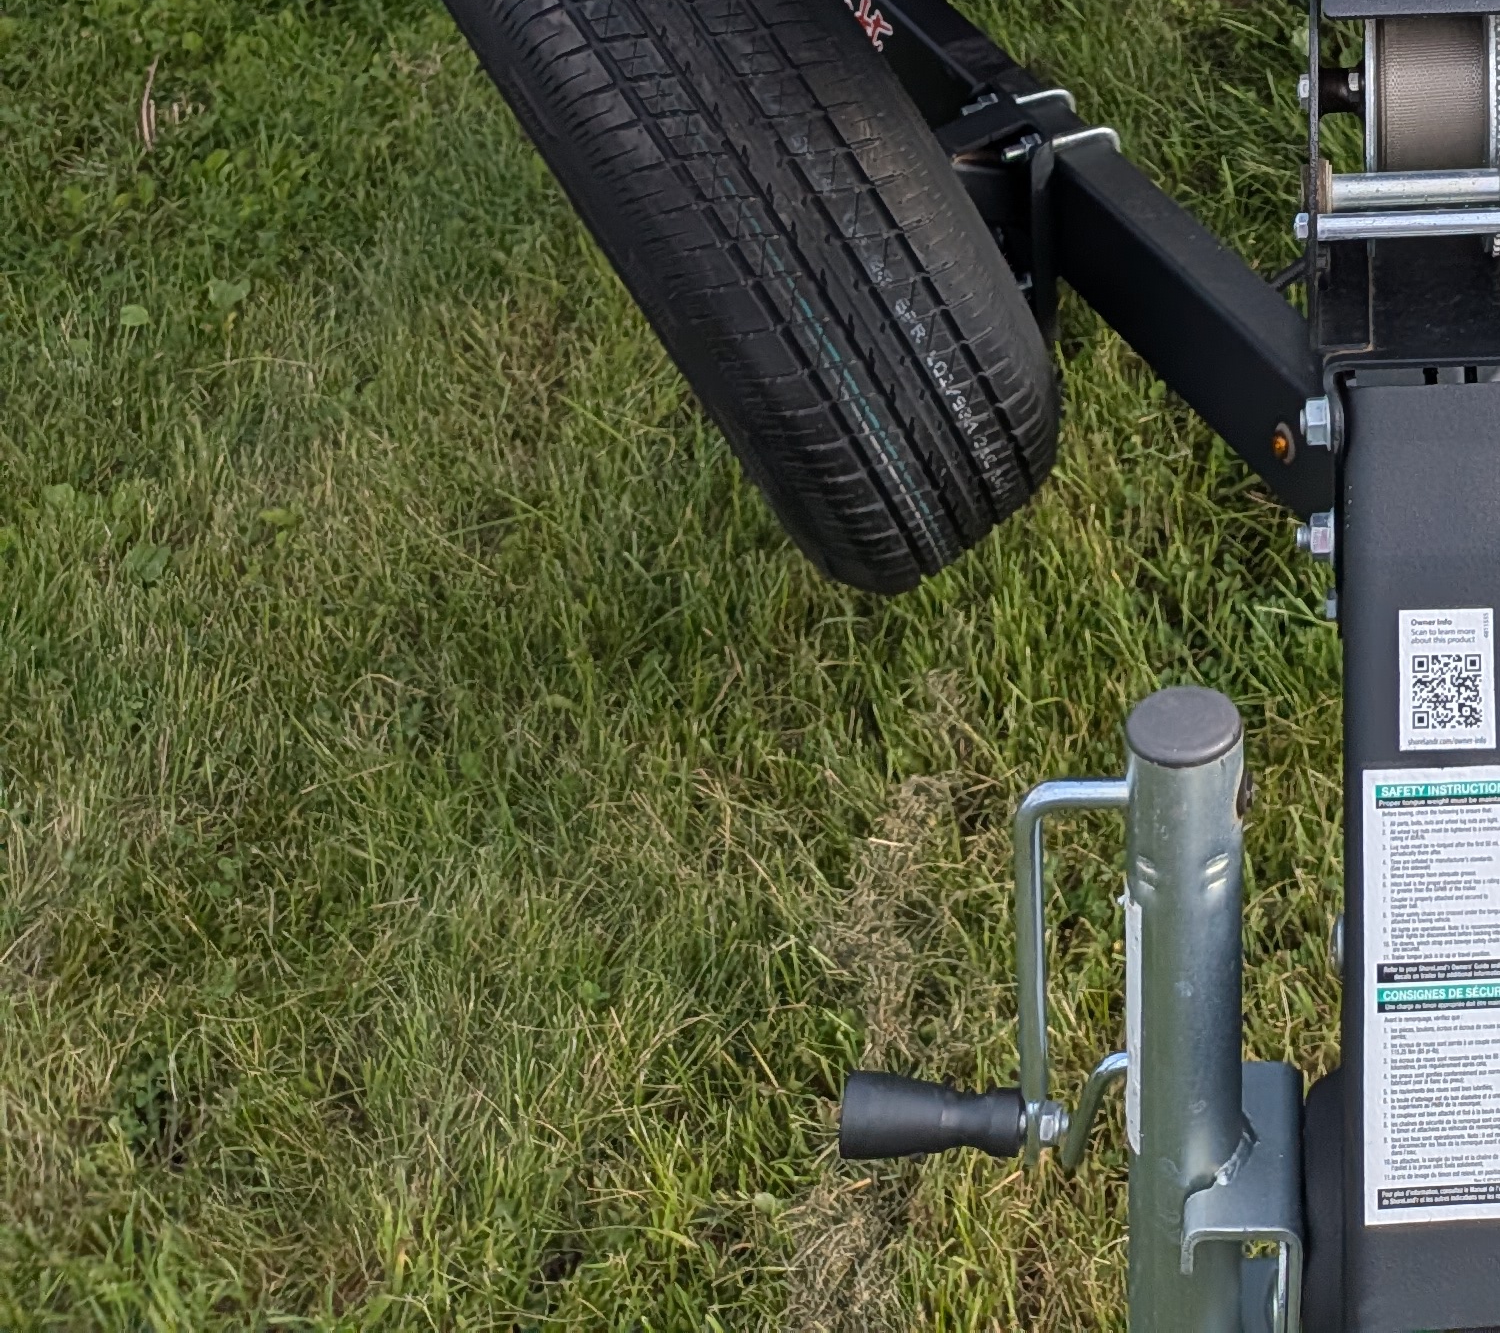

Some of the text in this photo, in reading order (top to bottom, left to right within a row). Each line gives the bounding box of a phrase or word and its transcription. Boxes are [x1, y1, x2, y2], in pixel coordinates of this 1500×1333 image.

[1448, 636, 1475, 644] product
[1382, 786, 1425, 797] SAFETY
[1383, 989, 1446, 1001] CONSIGNES
[1448, 988, 1463, 999] DE
